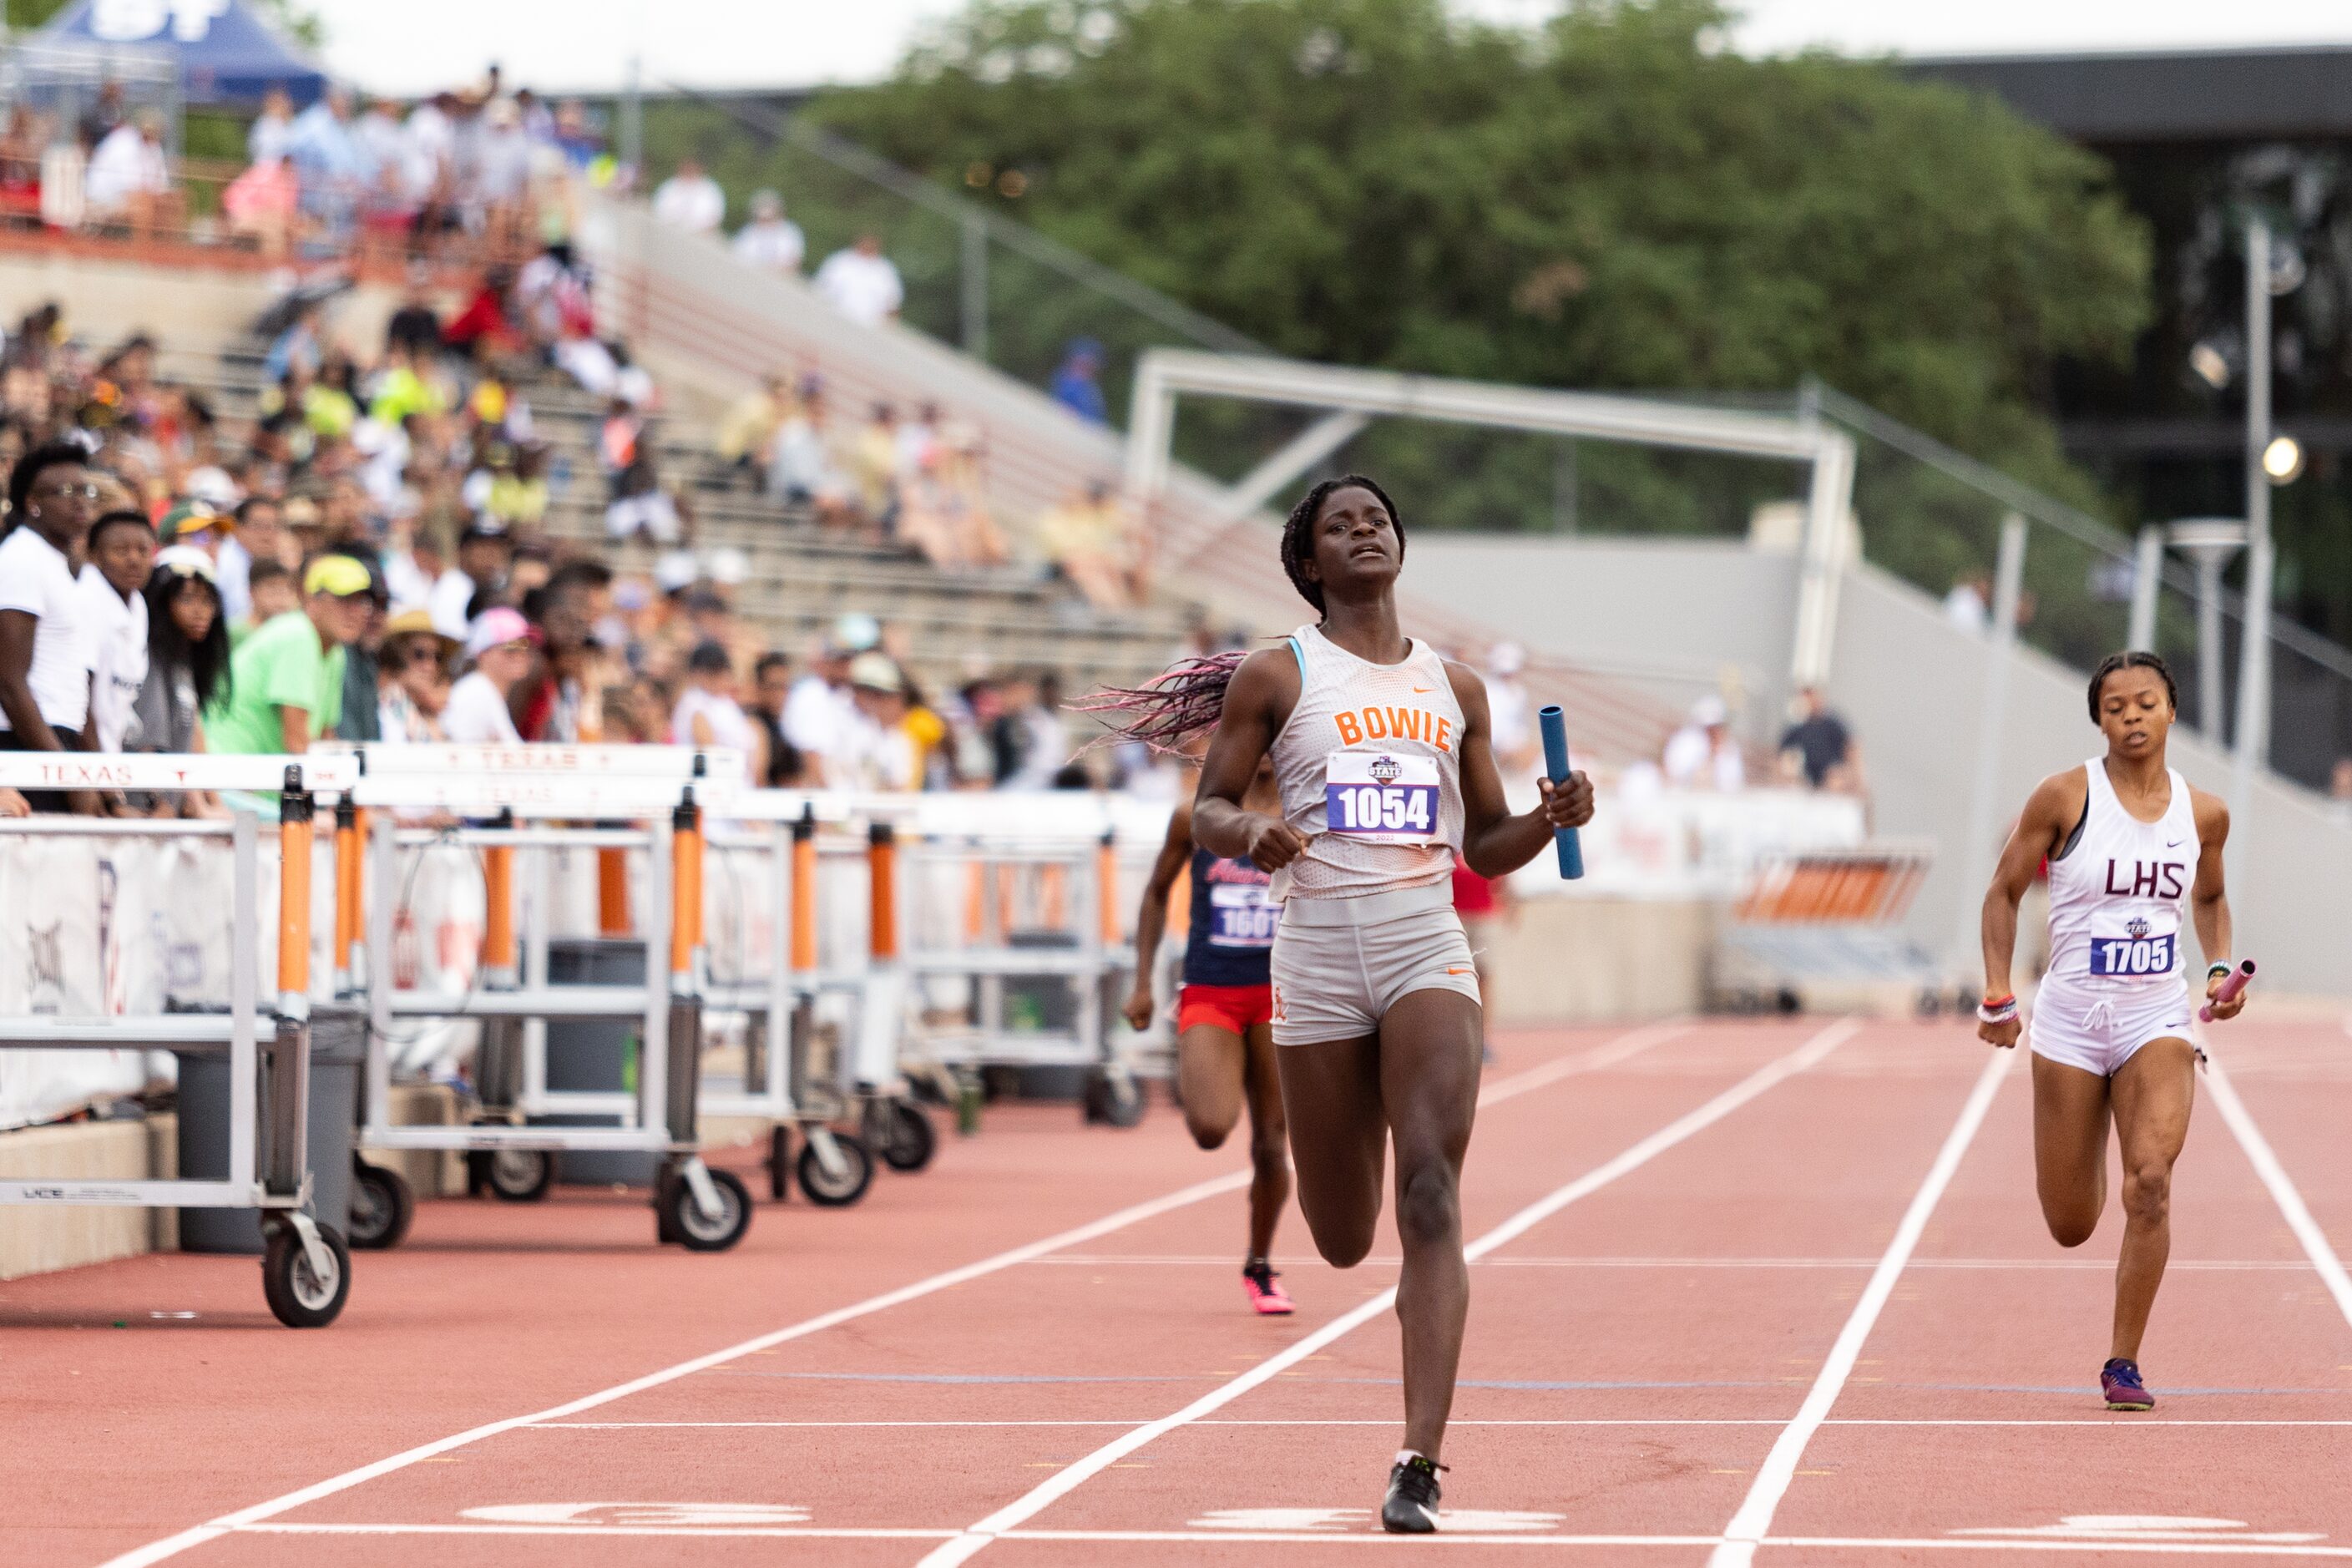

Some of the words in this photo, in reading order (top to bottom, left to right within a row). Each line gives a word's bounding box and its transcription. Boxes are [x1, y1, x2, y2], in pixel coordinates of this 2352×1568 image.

[1333, 706, 1451, 753] BOWIE
[40, 763, 132, 785] TEXAS
[1368, 766, 1403, 776] STATE
[1338, 787, 1430, 829] 1054
[2104, 858, 2185, 899] LHS
[2102, 938, 2168, 973] 1705
